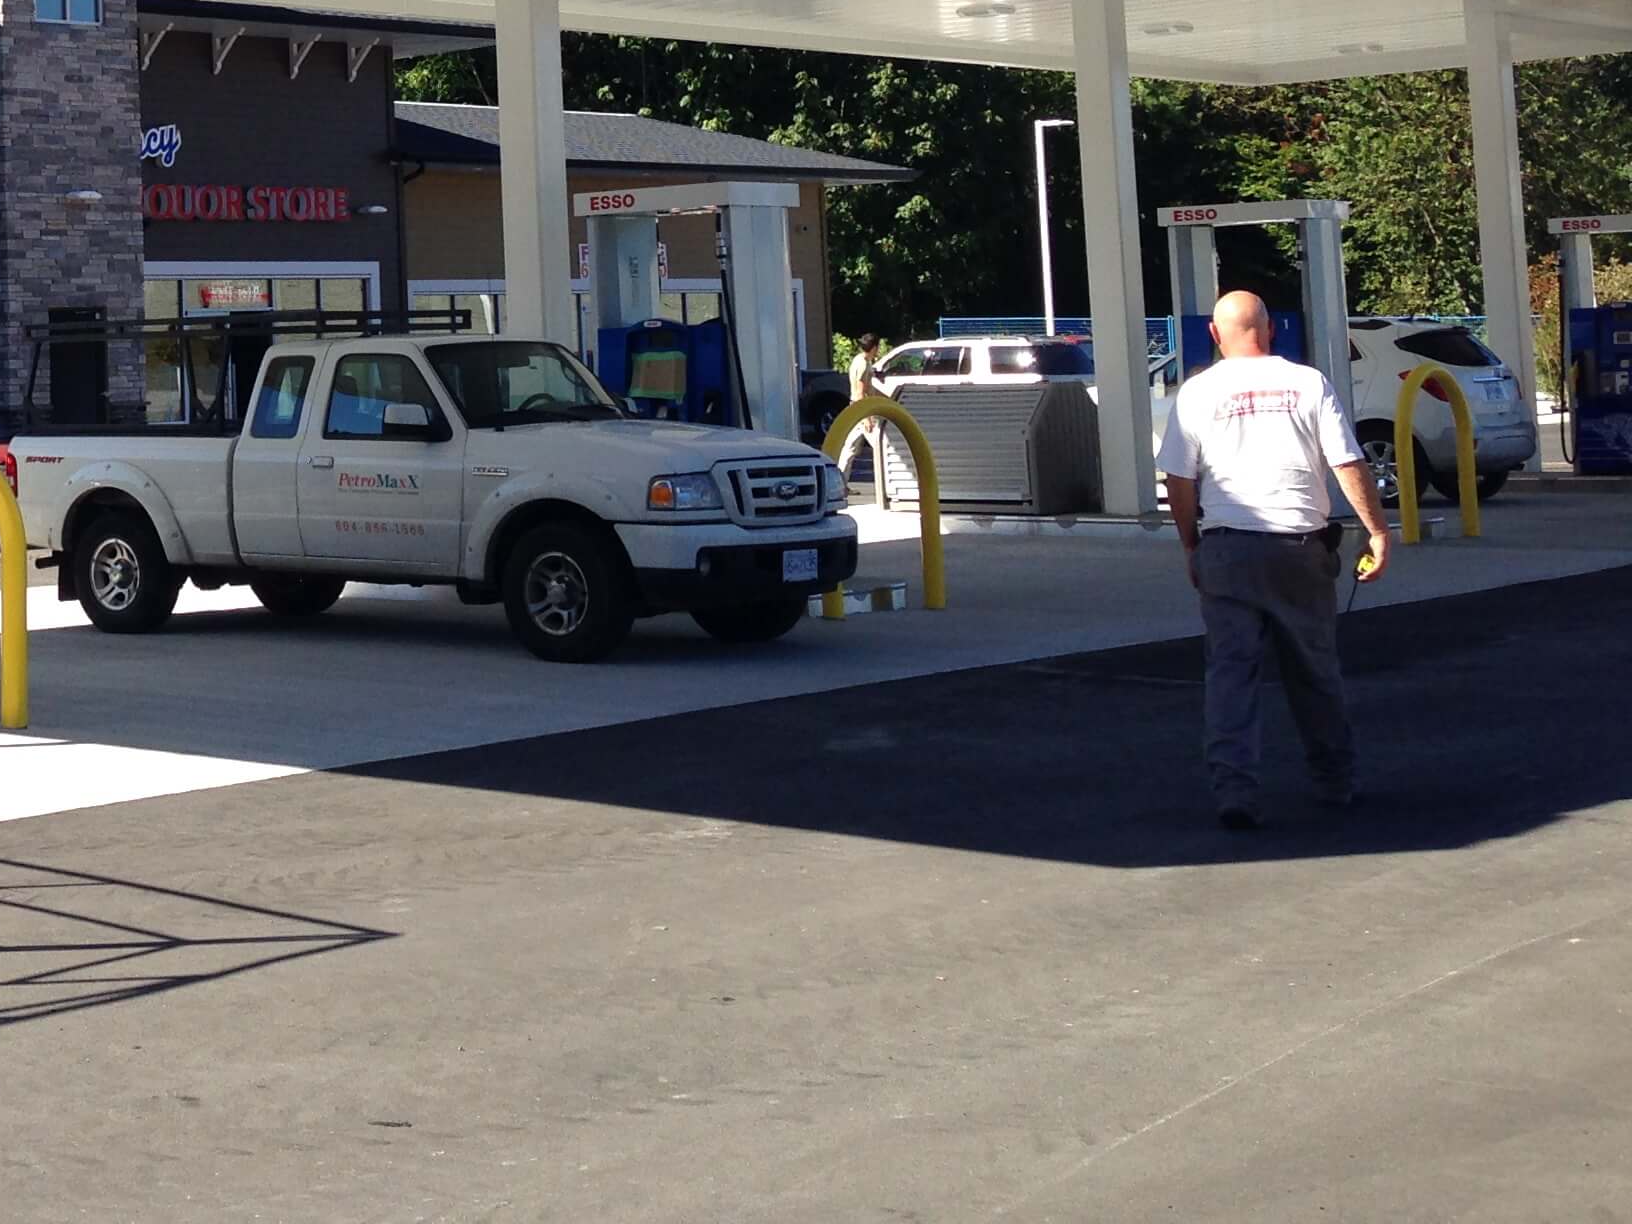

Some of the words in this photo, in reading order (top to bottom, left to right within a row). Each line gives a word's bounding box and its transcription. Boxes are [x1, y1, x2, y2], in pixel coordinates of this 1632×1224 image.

[247, 186, 352, 221] STORE
[590, 194, 635, 211] ESSO
[1173, 208, 1218, 222] ESSO
[1562, 219, 1601, 231] ESSO
[25, 456, 65, 464] SPORT
[338, 473, 419, 489] PetroMaxX
